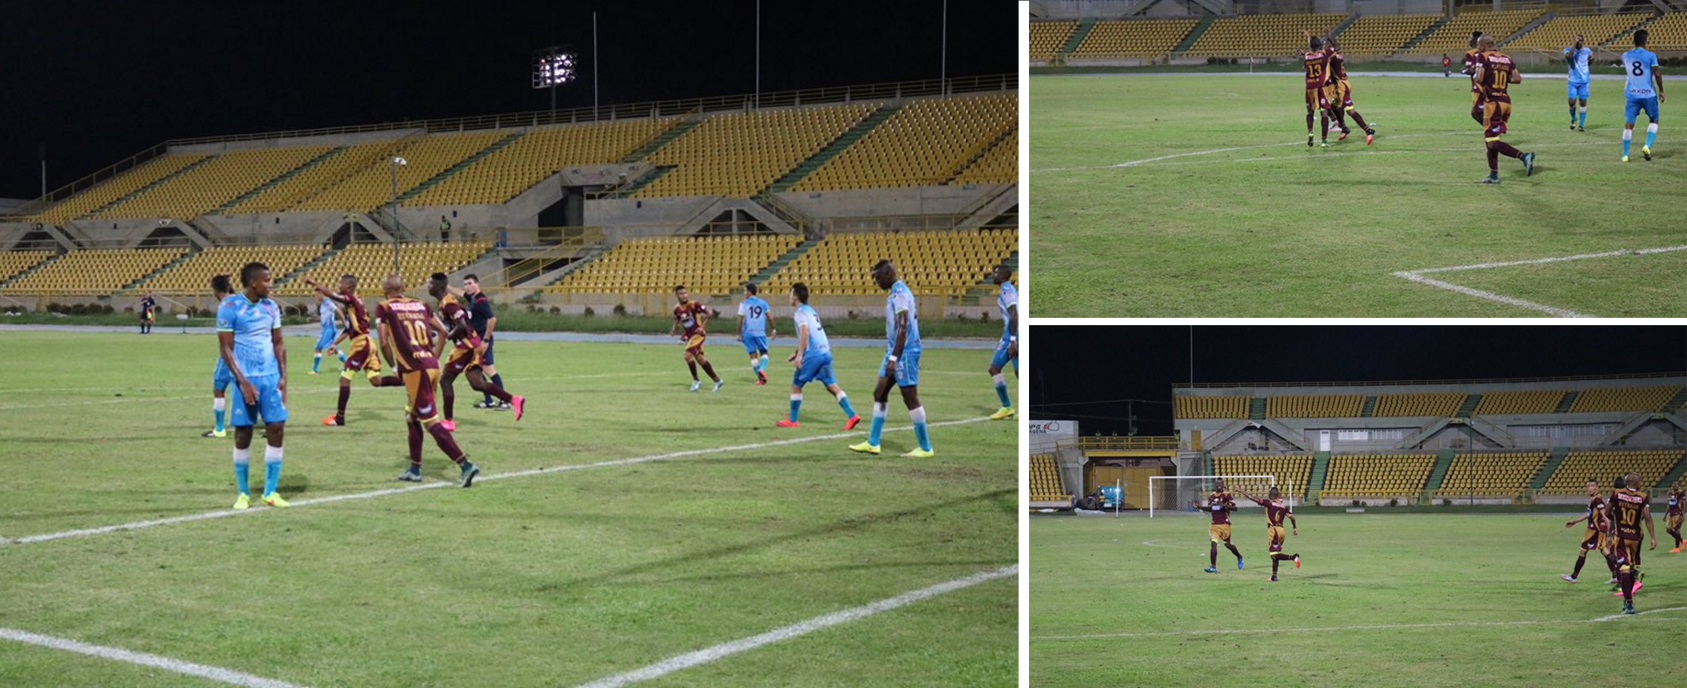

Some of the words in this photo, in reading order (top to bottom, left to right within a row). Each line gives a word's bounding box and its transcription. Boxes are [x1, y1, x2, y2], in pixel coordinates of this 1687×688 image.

[1308, 64, 1322, 78] 13
[1632, 60, 1644, 77] 8
[1492, 70, 1507, 89] 10
[749, 305, 762, 320] 19
[403, 320, 429, 346] 10
[1275, 510, 1281, 522] 6
[1620, 507, 1636, 526] 10
